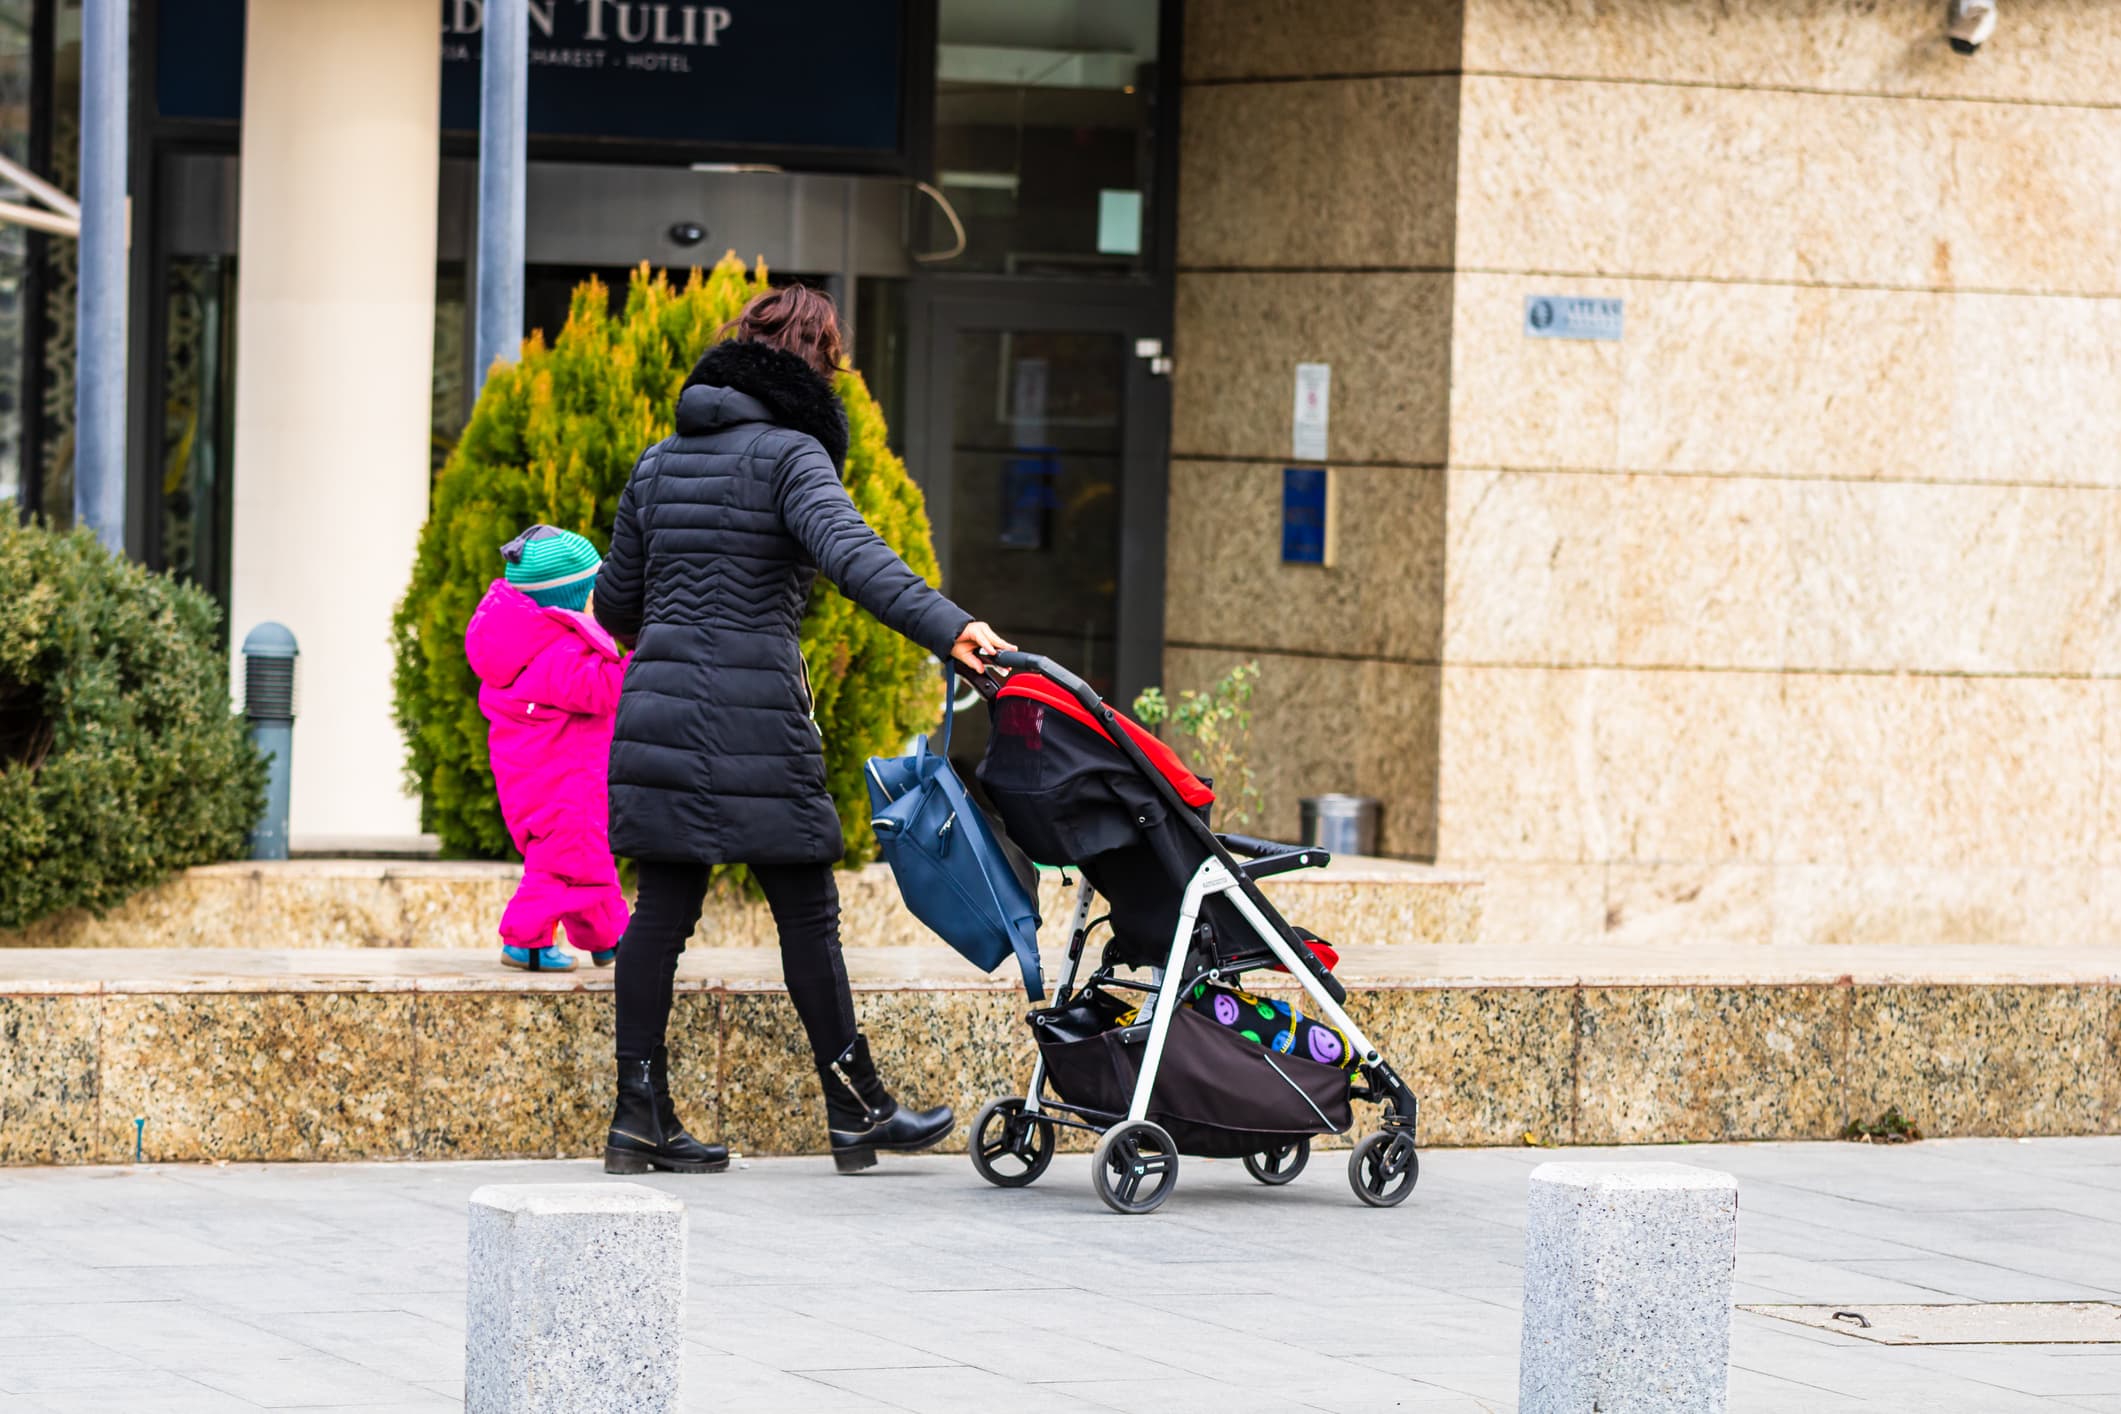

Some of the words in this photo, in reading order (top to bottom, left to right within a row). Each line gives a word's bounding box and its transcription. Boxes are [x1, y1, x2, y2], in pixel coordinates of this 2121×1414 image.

[576, 0, 732, 46] TULIP
[528, 47, 606, 68] HAREST
[625, 52, 693, 73] HOTEL
